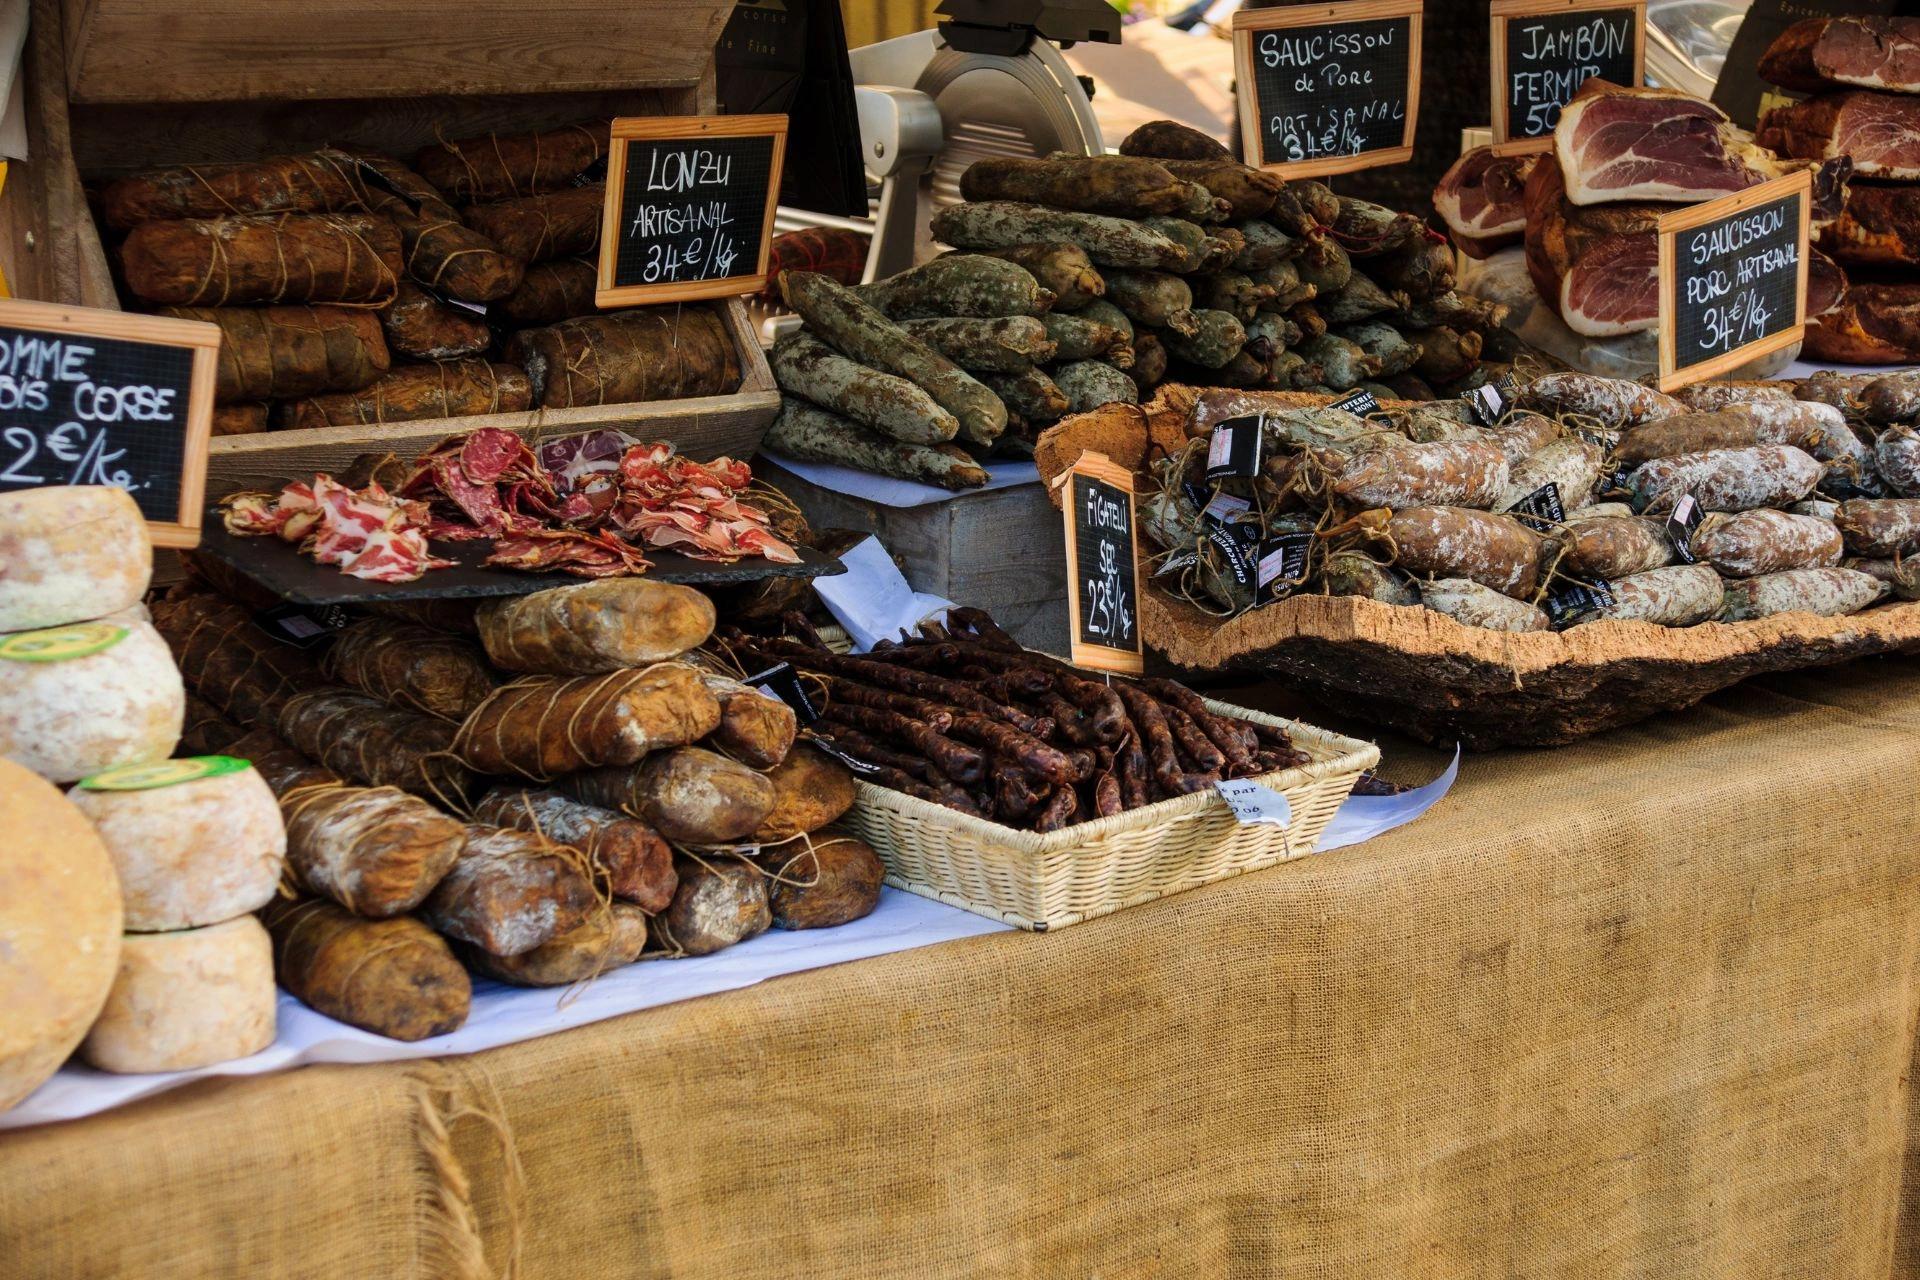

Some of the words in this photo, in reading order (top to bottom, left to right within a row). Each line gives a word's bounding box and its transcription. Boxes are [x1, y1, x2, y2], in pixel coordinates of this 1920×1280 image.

[1521, 17, 1629, 61] JAMBON
[1294, 73, 1315, 92] de
[646, 148, 732, 193] LONZU
[1690, 206, 1785, 265] SAUCISSON
[1686, 270, 1732, 304] PORC
[74, 381, 177, 423] CORSE
[1546, 485, 1562, 524] CHARCUT
[1098, 538, 1118, 575] SEC
[1232, 786, 1257, 796] par
